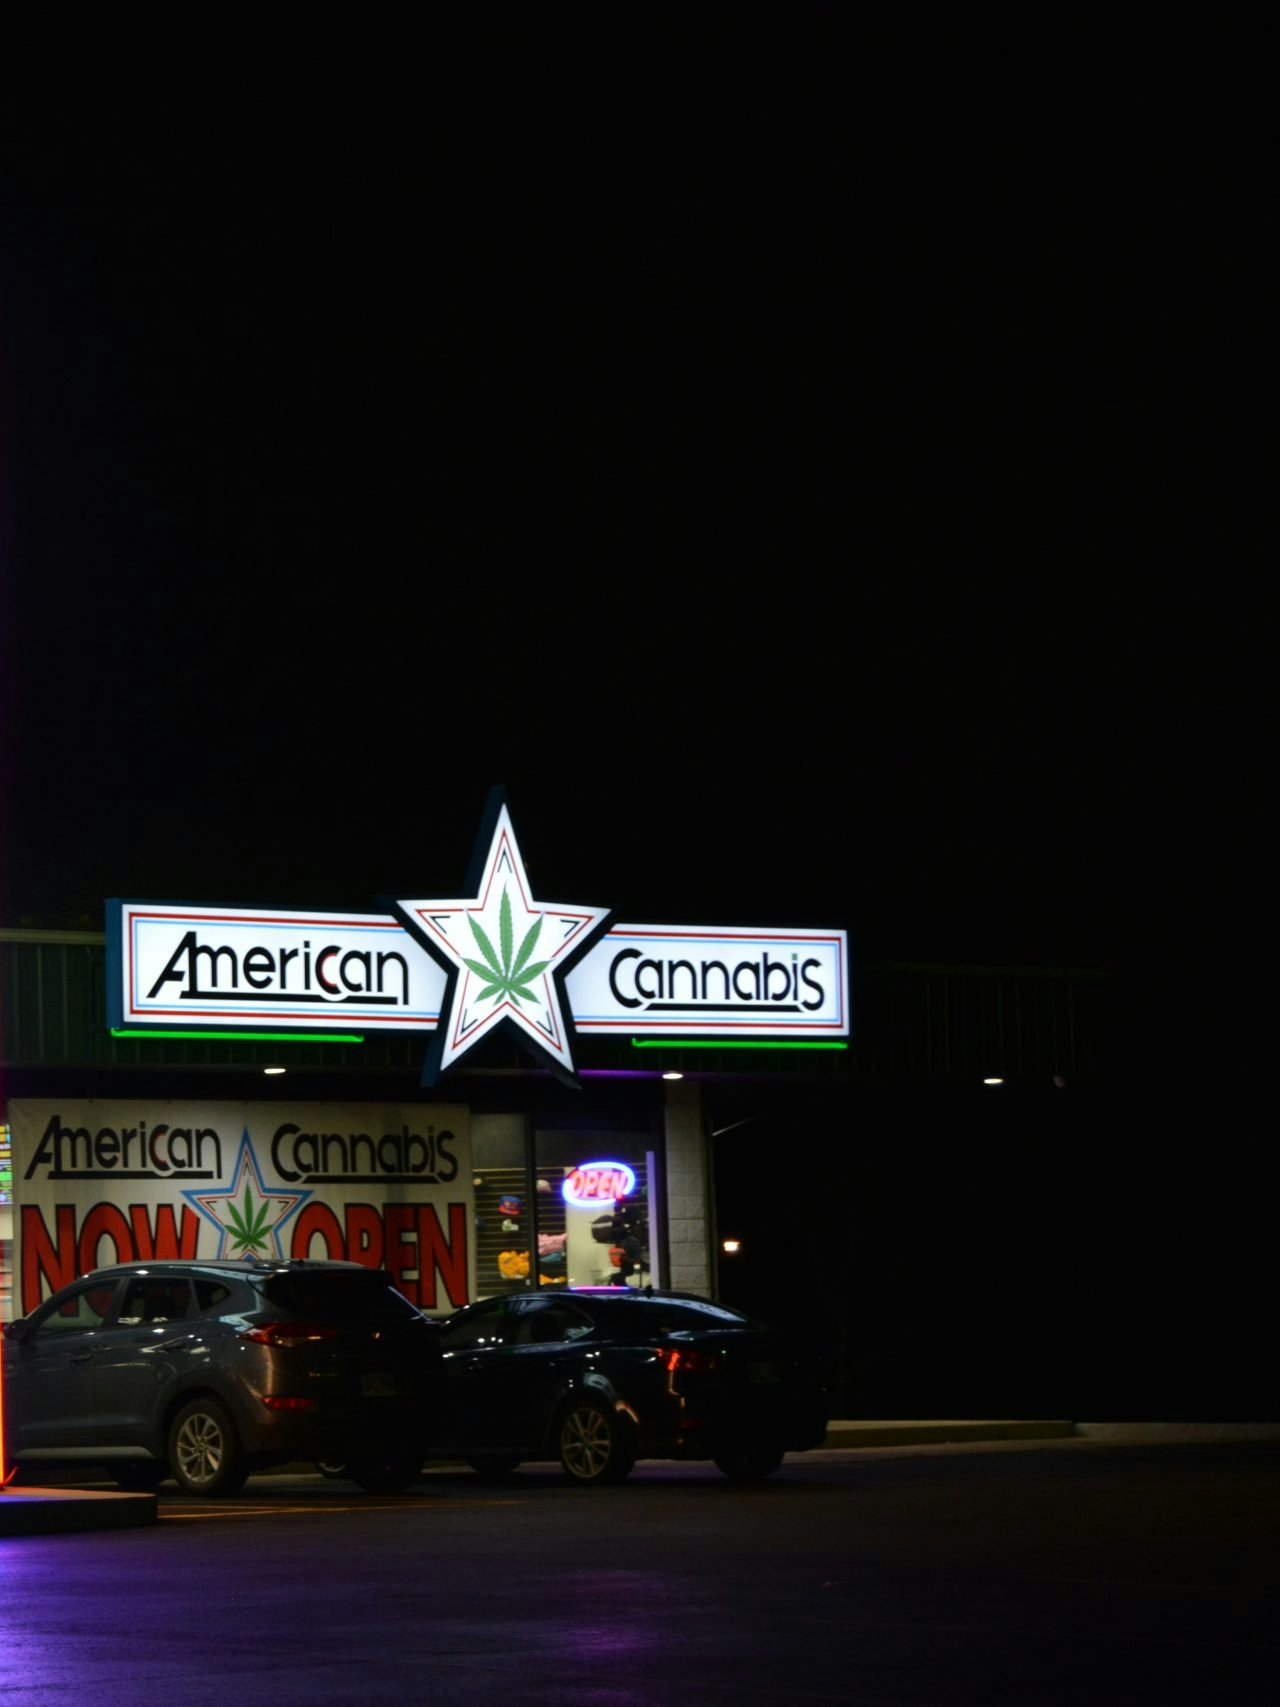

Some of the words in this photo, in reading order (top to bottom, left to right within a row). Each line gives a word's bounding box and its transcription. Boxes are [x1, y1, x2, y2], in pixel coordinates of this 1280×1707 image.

[147, 931, 411, 1005] American
[609, 950, 825, 1011] Cannabis
[24, 1115, 222, 1180] American
[271, 1123, 458, 1184] Cannabis
[567, 1169, 628, 1199] OPEN
[21, 1202, 200, 1317] NOW
[291, 1201, 469, 1309] OPEN
